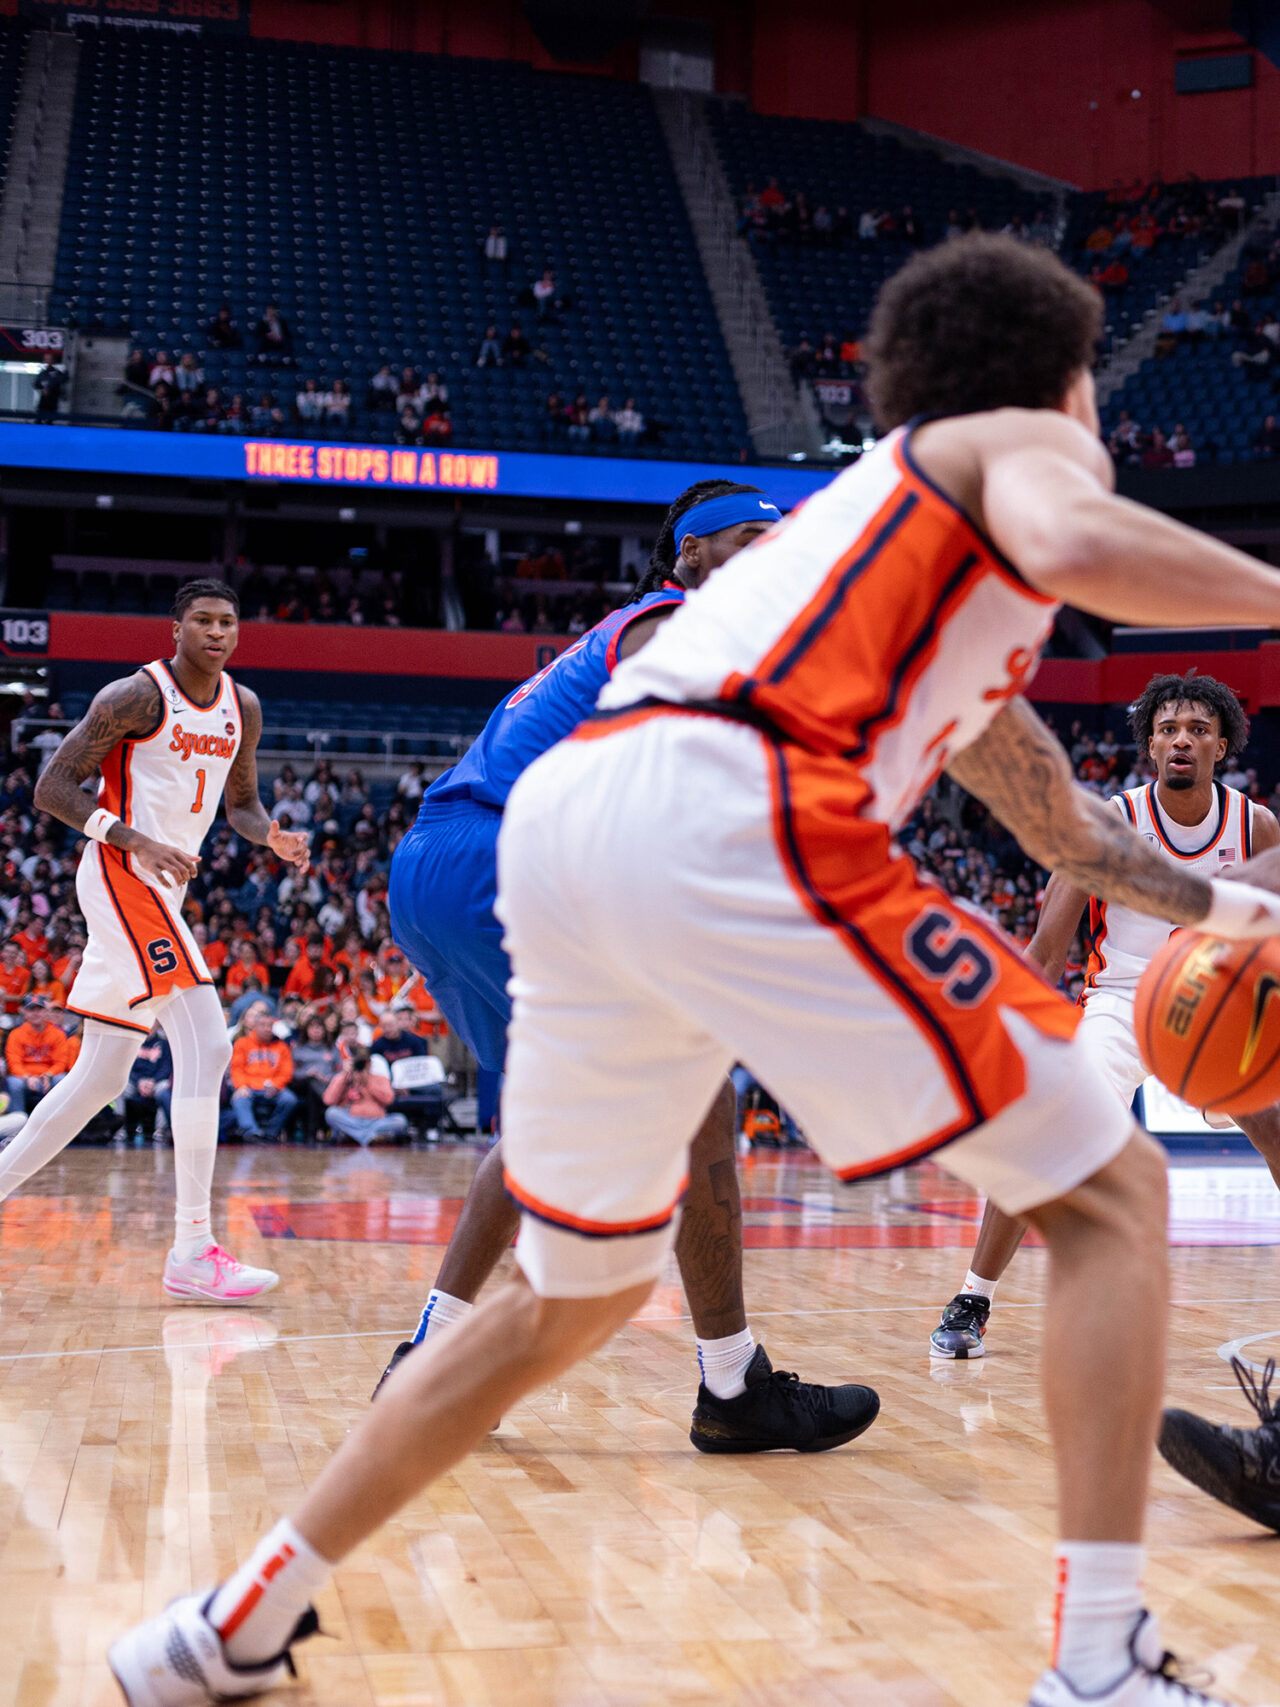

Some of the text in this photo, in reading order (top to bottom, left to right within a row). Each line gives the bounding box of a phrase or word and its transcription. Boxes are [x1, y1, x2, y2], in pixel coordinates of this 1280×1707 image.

[21, 329, 63, 350] 303
[245, 443, 498, 488] THREE STOPS IN A ROW!
[1, 619, 48, 645] 103
[190, 768, 206, 814] 1
[146, 937, 178, 975] S
[902, 903, 1001, 1010] S
